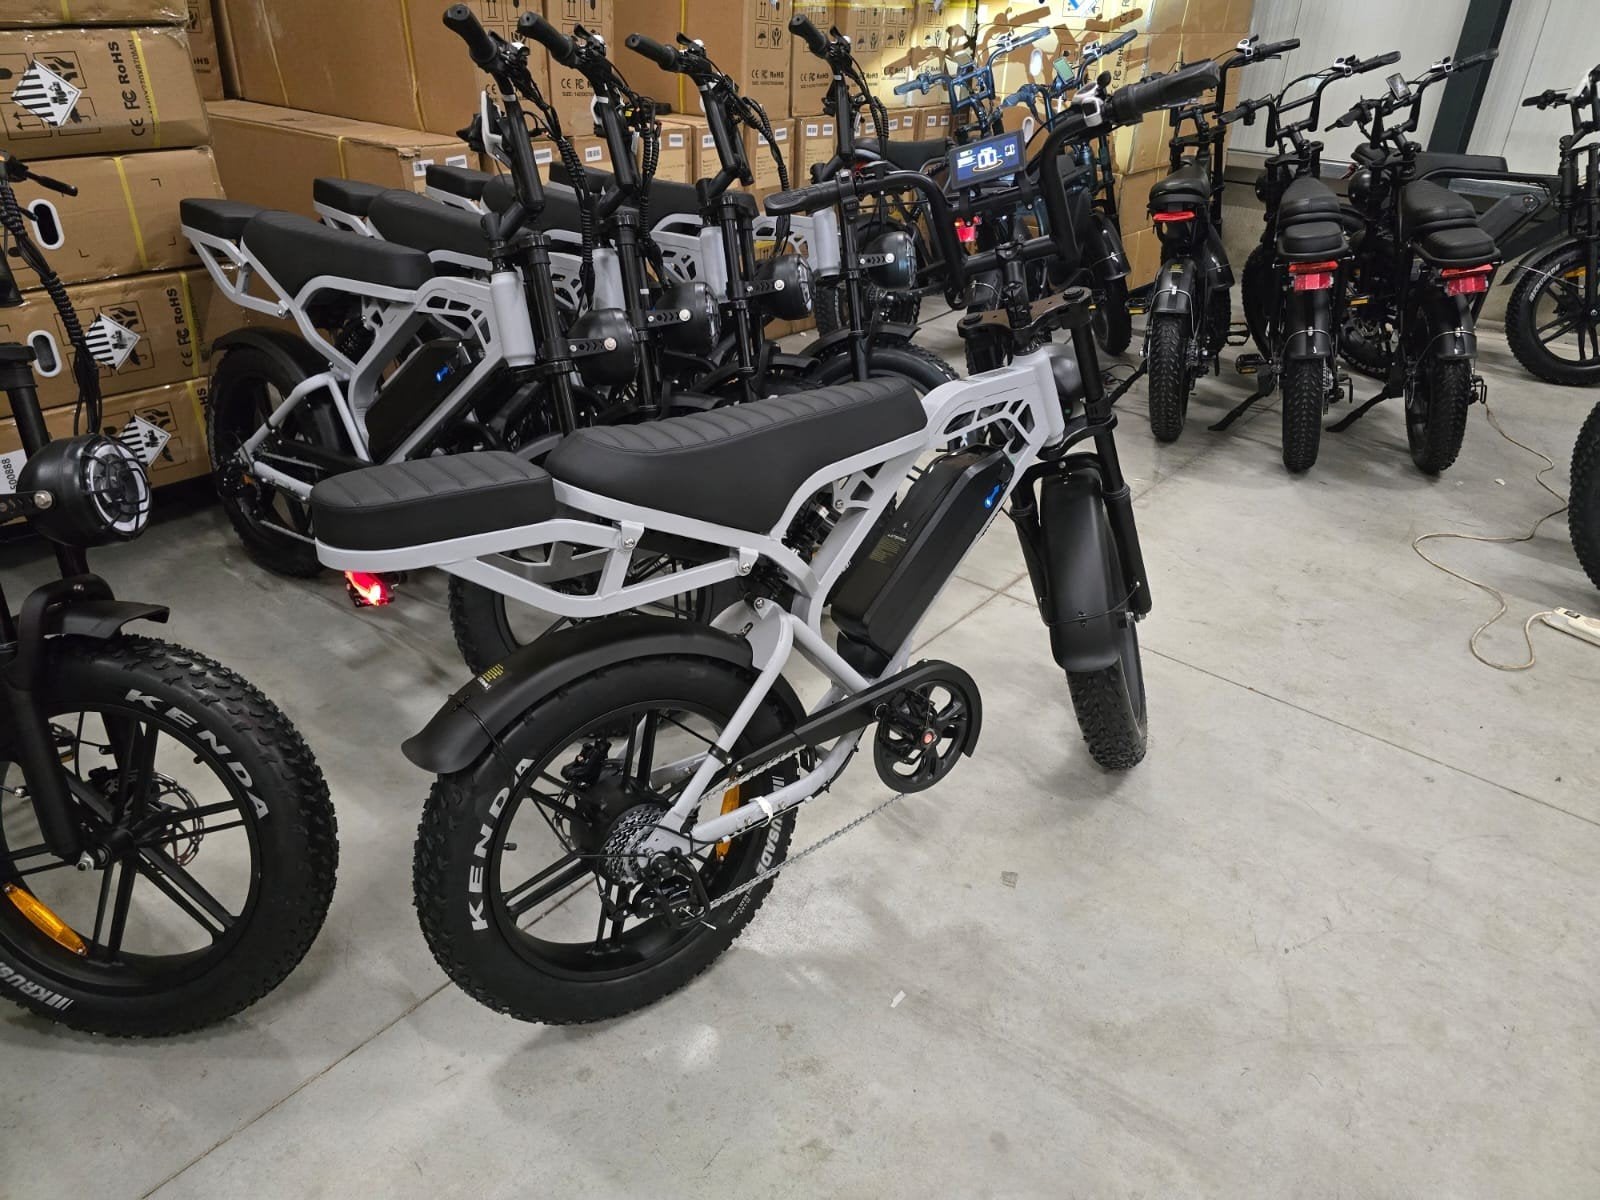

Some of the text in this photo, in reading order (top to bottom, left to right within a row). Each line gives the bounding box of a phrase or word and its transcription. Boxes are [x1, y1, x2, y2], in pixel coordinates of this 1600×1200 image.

[108, 41, 130, 85] RoHS
[1116, 47, 1124, 67] RoH
[560, 78, 572, 89] CE
[752, 69, 759, 79] CE
[770, 71, 785, 80] RoHS
[121, 89, 141, 110] FC
[130, 117, 146, 137] CE
[166, 287, 193, 368] CE FC RoHS
[124, 688, 270, 820] KENDA
[468, 757, 536, 931] KENDA
[755, 815, 784, 877] USADE
